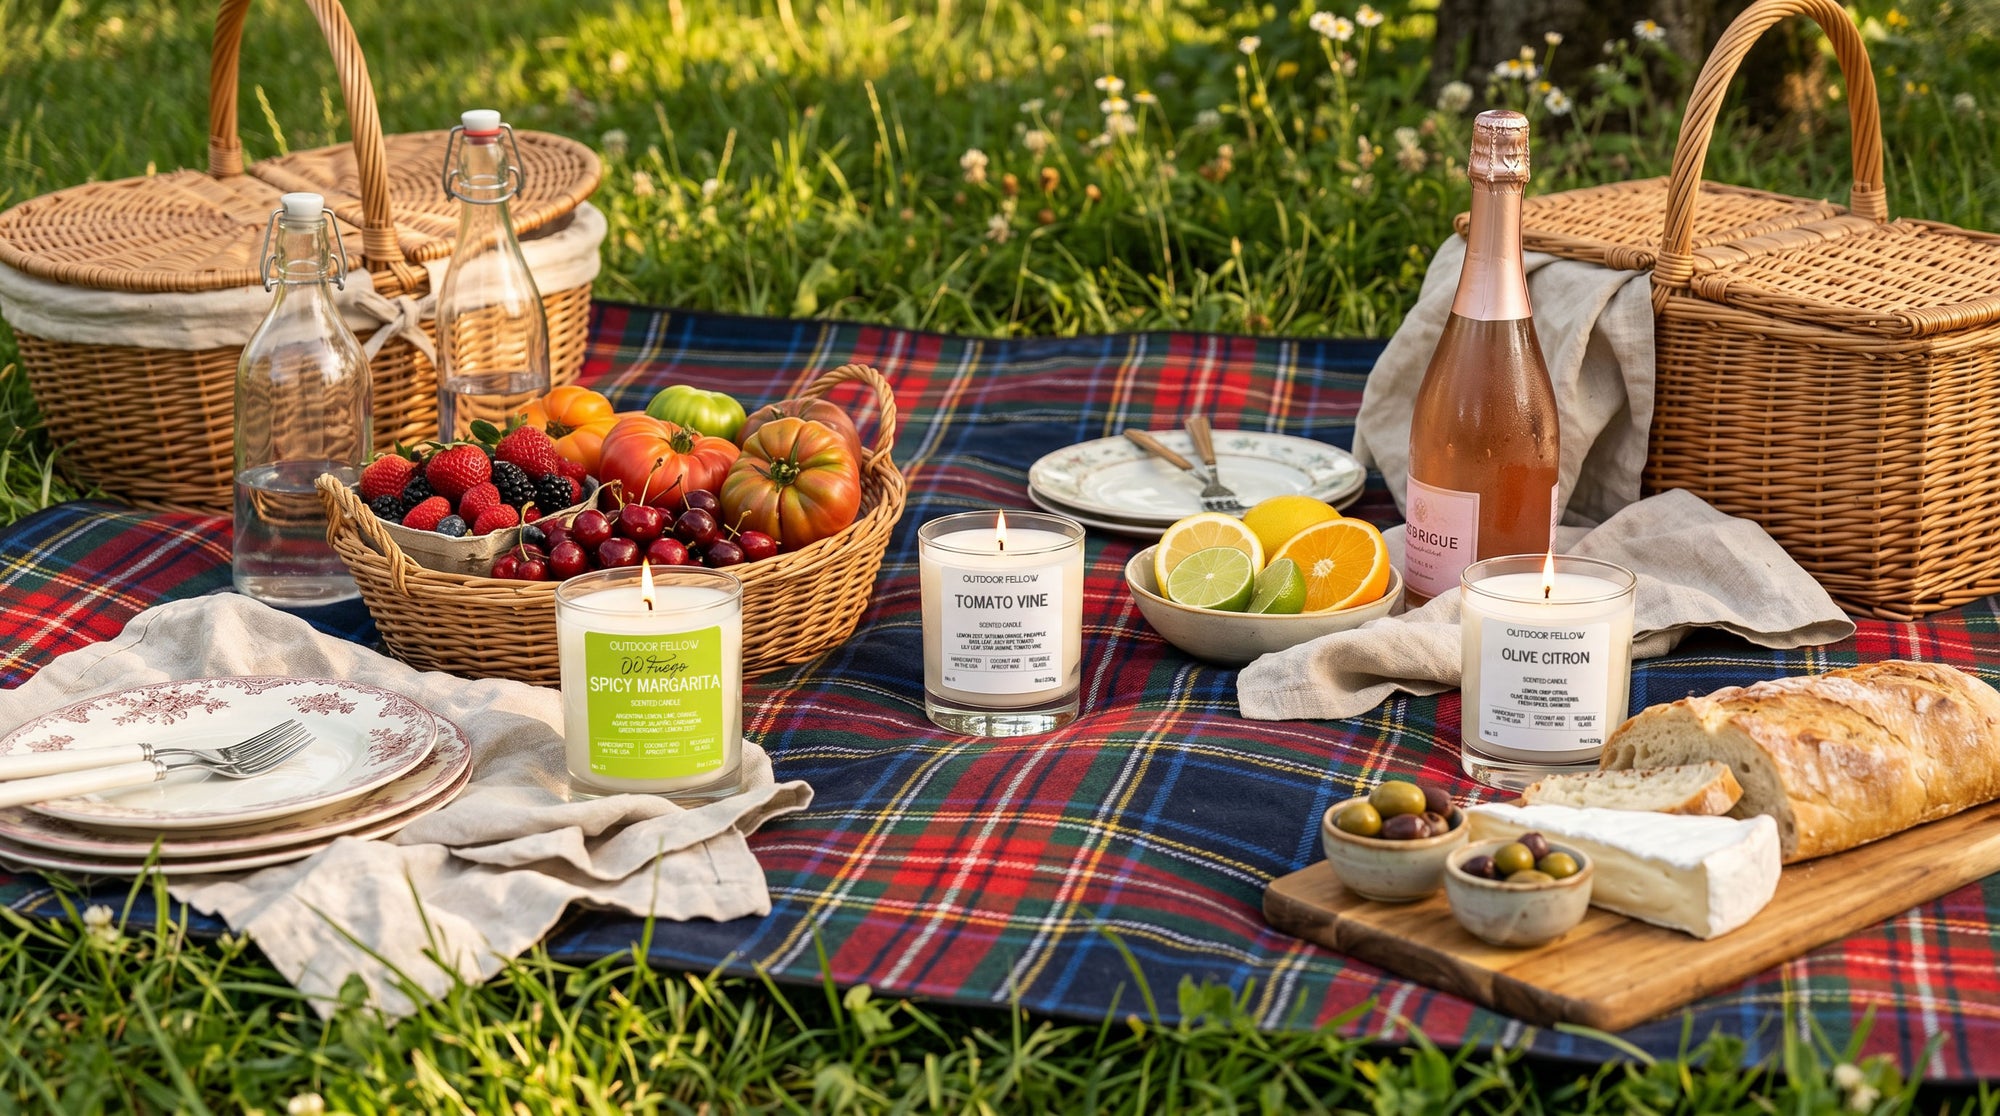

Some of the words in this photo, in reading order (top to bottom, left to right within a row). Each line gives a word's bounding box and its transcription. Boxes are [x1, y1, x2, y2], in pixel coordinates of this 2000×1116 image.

[962, 574, 1004, 584] OUTDOOR
[1005, 574, 1039, 584] FELLOW
[955, 593, 1013, 609] TOMATO
[1017, 593, 1048, 608] VINE
[1506, 628, 1549, 640] OUTDOOR
[1550, 631, 1586, 640] FELLOW
[609, 641, 658, 651] OUTDOOR
[660, 640, 699, 651] FELLOW
[1502, 647, 1538, 664] OLIVE
[1542, 651, 1590, 665] CITRON
[646, 653, 689, 679] Fuego
[590, 676, 633, 693] SPICY
[637, 674, 720, 693] MARGARITA
[1522, 676, 1546, 684] SCENTED
[630, 699, 657, 707] SCENTED
[1492, 709, 1525, 719] HANDCRAFTED
[597, 741, 634, 749] HANDCRAFTED
[690, 737, 714, 746] REUSABLE
[694, 743, 710, 751] GLASS
